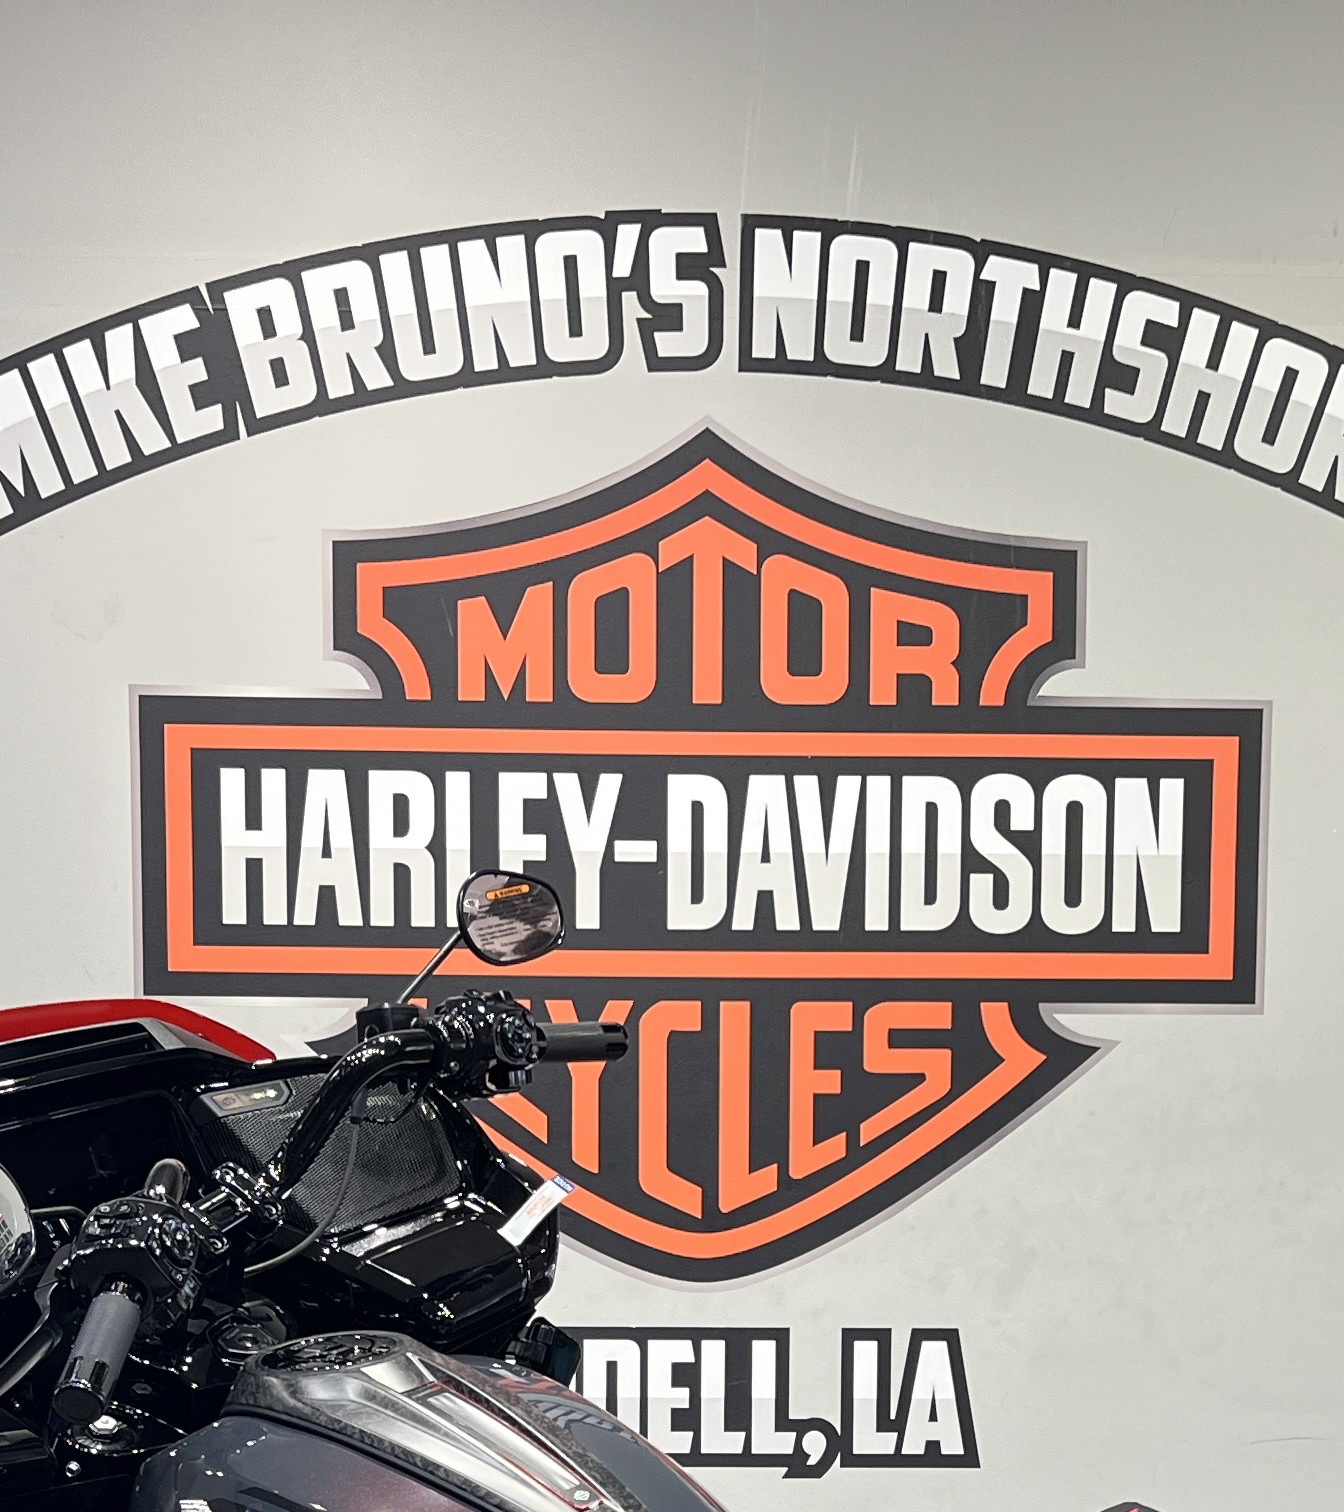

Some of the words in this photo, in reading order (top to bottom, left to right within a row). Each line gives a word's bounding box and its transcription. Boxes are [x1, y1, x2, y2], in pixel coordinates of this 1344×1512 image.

[224, 223, 709, 418] BRUNO'S
[457, 516, 960, 706] MOTOR
[484, 1000, 954, 1220] YCLES
